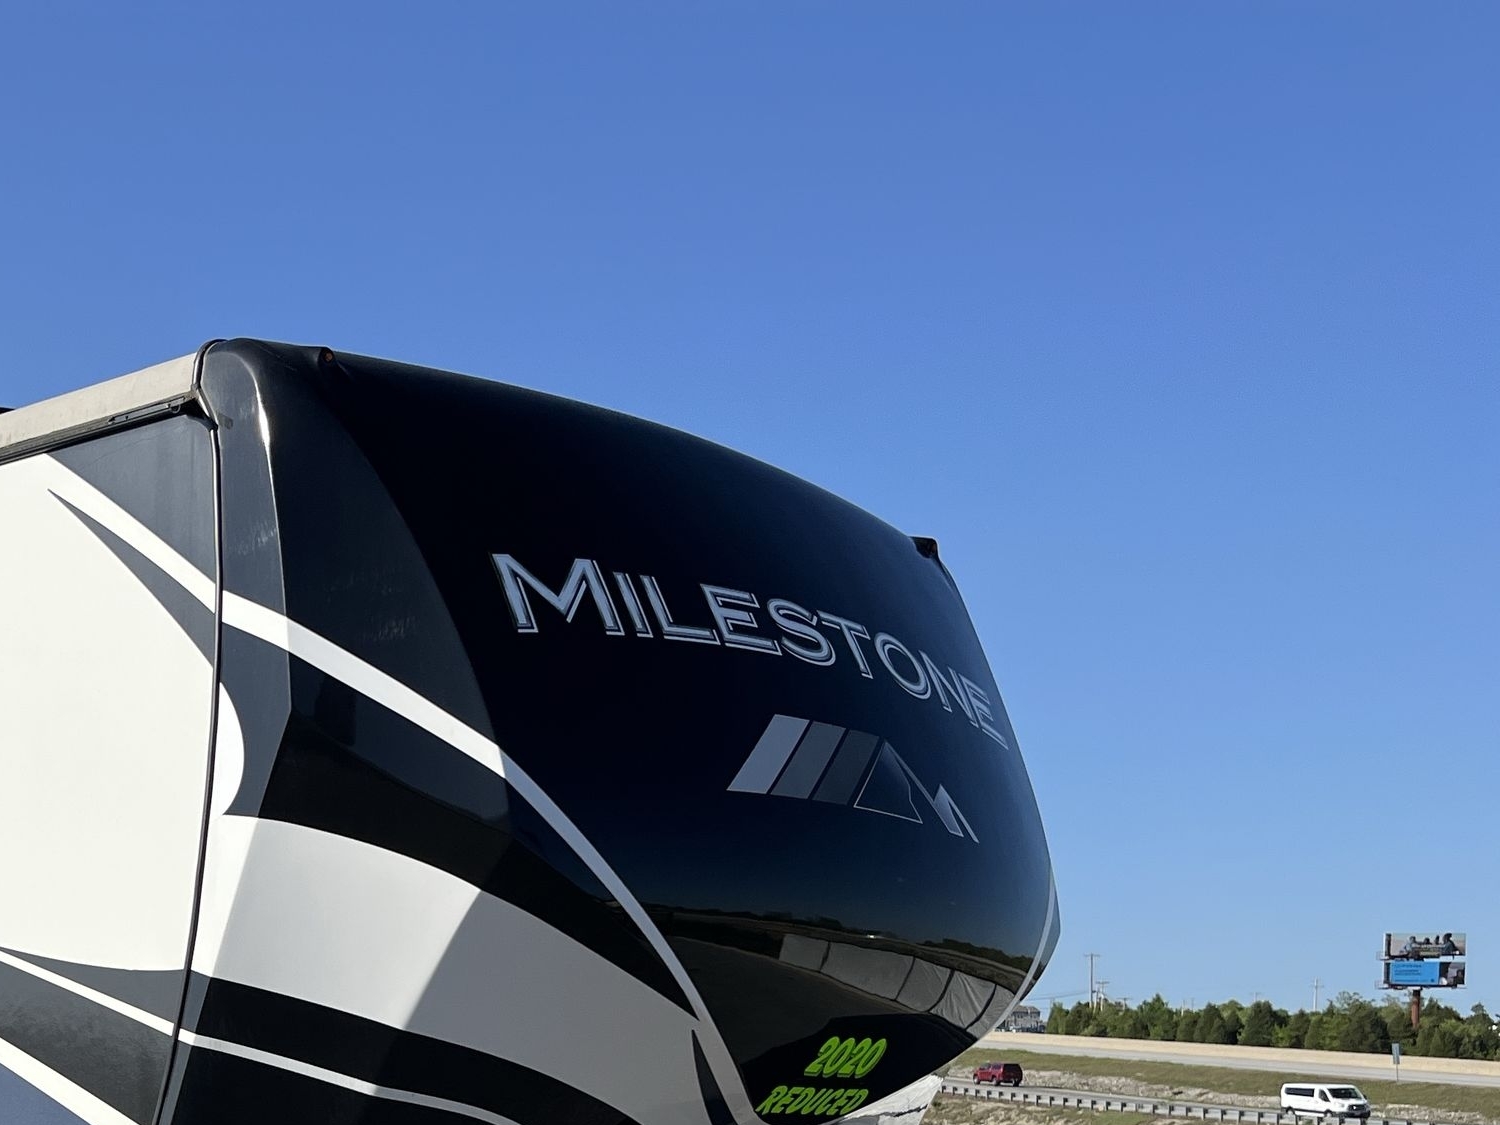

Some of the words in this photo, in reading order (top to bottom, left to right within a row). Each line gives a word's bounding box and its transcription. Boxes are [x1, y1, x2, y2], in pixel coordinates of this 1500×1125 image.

[490, 552, 1008, 749] MILESTONE
[804, 1036, 887, 1078] 2020
[755, 1085, 869, 1115] REDUCED
